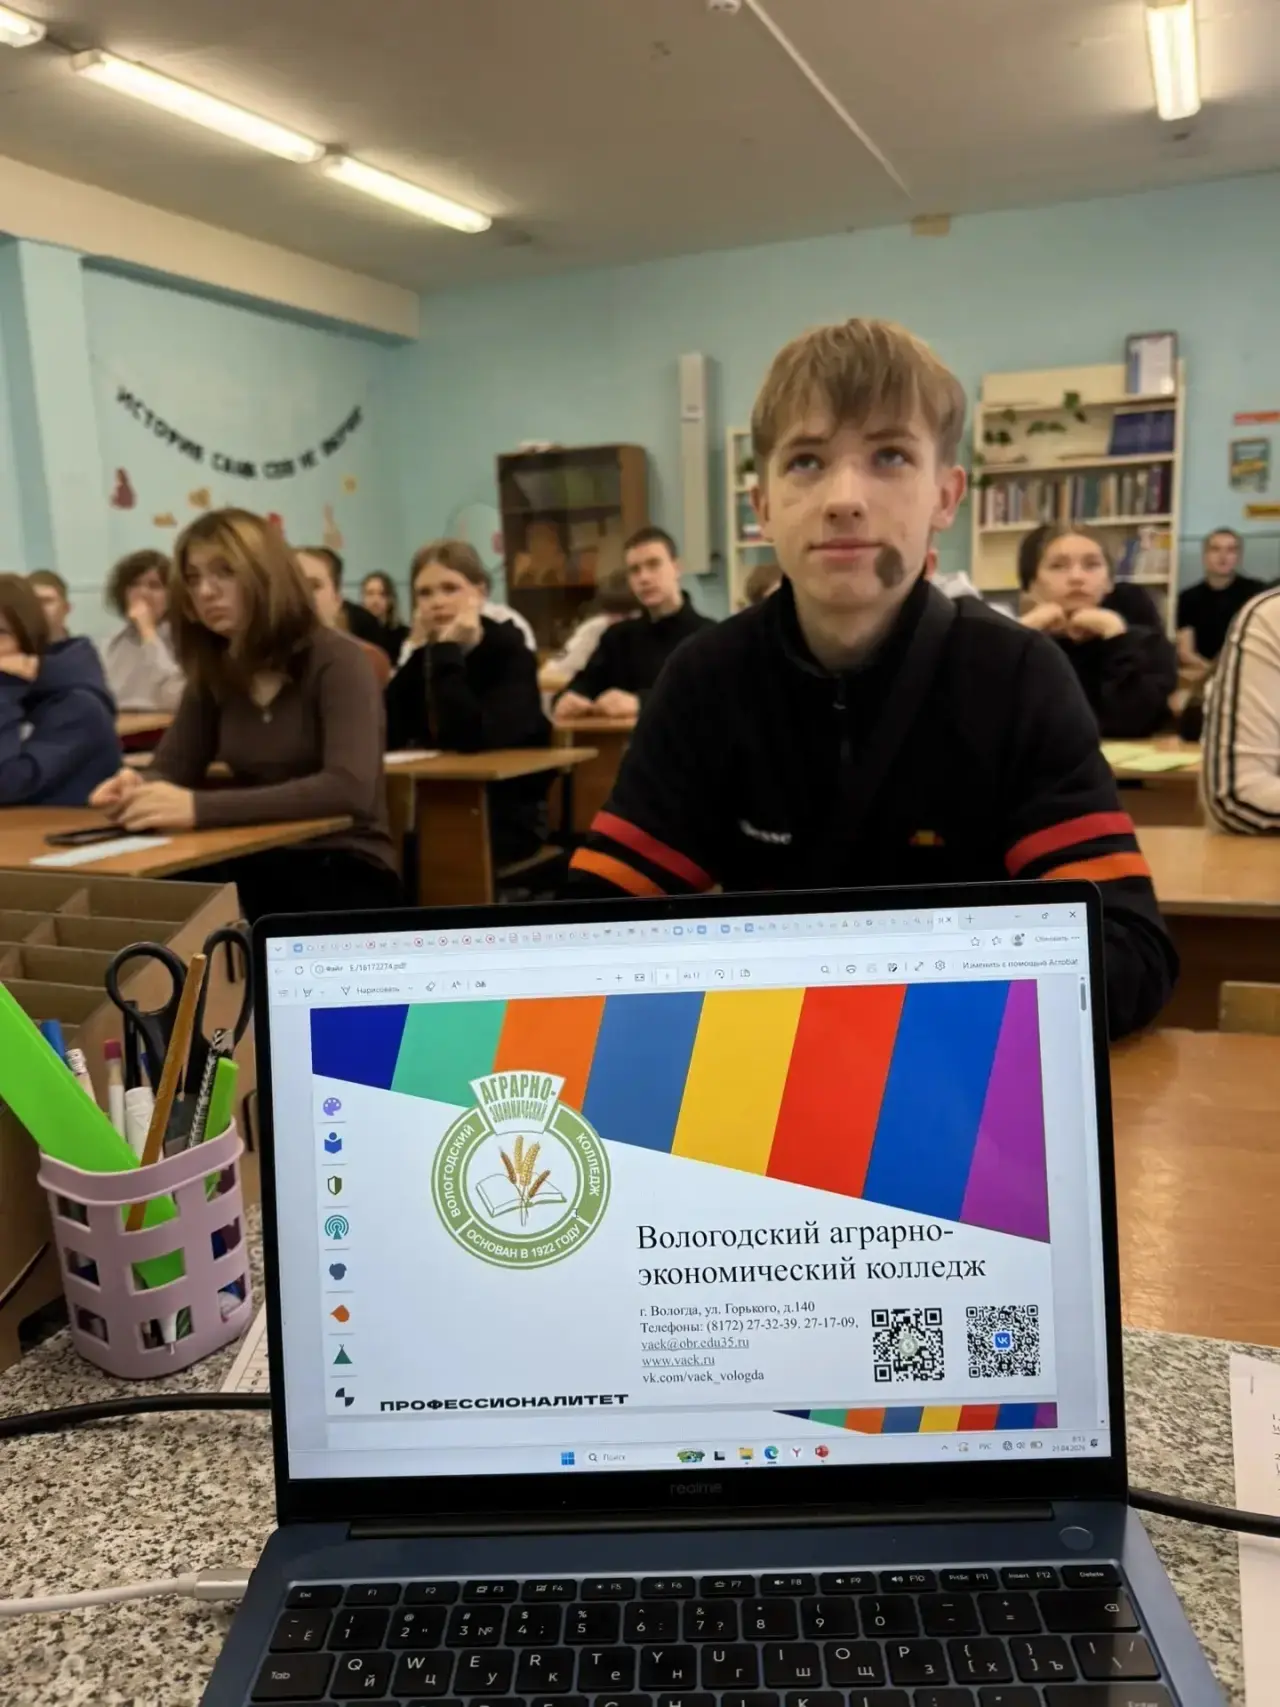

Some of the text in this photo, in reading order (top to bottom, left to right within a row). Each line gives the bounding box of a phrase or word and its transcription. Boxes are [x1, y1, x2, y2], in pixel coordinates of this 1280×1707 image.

[480, 1074, 556, 1105] АГРАРНО-
[576, 1132, 601, 1196] КОЛЛЕДЖ
[443, 1124, 475, 1218] ВОЛОГОДСКИЙ
[466, 1224, 581, 1258] ОСНОВАН В 1922 ГОДУ
[636, 1222, 954, 1251] Вологодский аграрно-
[638, 1255, 986, 1287] экономический колледж
[640, 1301, 815, 1319] г. Вологда, ул. Горького, д.140
[640, 1321, 703, 1335] Телефоны:
[706, 1319, 744, 1333] (8172)
[380, 1394, 629, 1411] ПРОФЕССИОНАЛИТЕТ
[603, 1453, 626, 1461] Поиск
[670, 1481, 723, 1494] realme
[493, 1585, 504, 1593] F3
[404, 1613, 414, 1622] @
[578, 1610, 587, 1618] %
[578, 1623, 586, 1633] 5
[637, 1622, 646, 1631] 6
[696, 1620, 704, 1630] 7
[756, 1619, 765, 1629] 8
[816, 1618, 824, 1628] 9
[401, 1627, 410, 1637] 2
[459, 1626, 468, 1635] 3
[518, 1625, 527, 1634] 4
[652, 1651, 663, 1663] Y
[713, 1650, 725, 1662] U
[835, 1648, 850, 1659] O
[898, 1646, 910, 1658] P
[407, 1657, 425, 1669] W
[470, 1655, 480, 1667] E
[530, 1654, 541, 1666] R
[592, 1653, 602, 1664] T
[347, 1659, 363, 1670] Q
[271, 1671, 290, 1679] Tab
